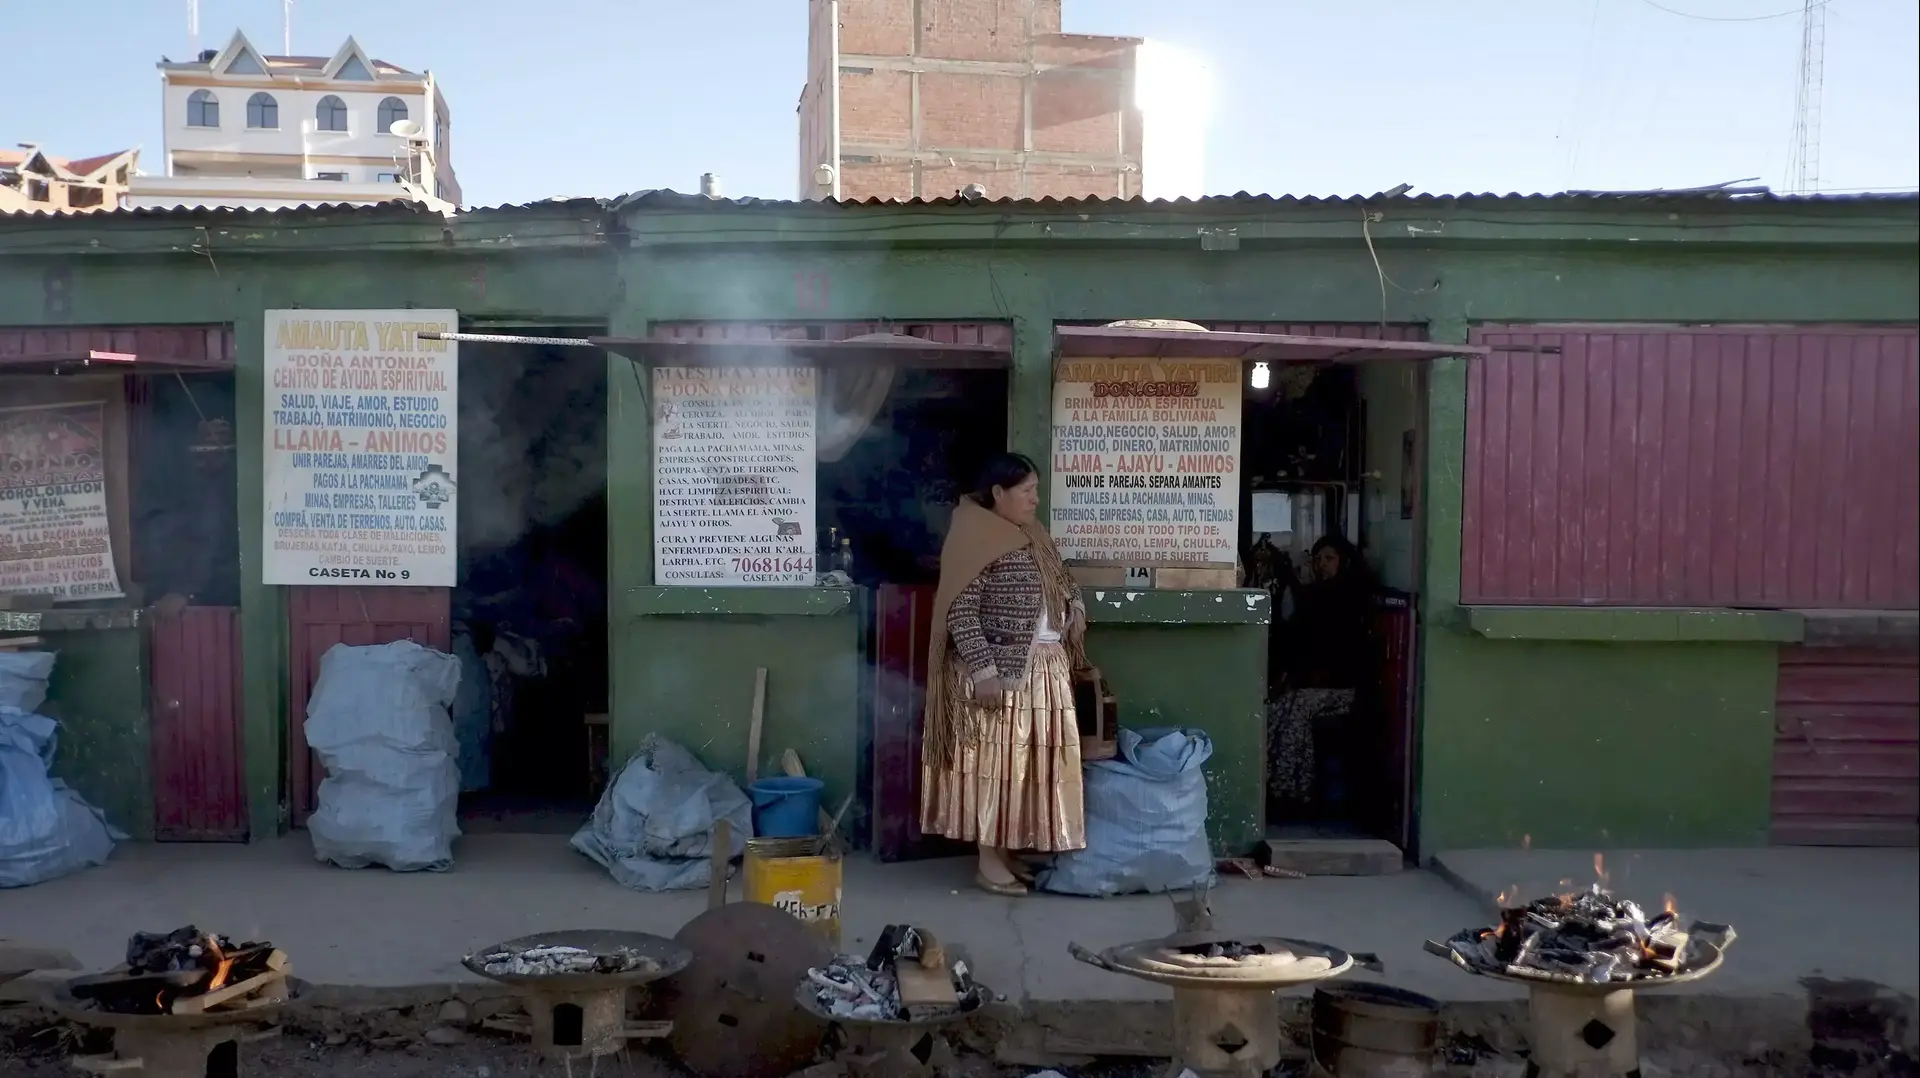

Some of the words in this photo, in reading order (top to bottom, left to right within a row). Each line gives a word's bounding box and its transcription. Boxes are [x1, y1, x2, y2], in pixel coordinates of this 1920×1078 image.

[276, 320, 369, 351] AMAUTA
[1055, 363, 1155, 383] AMAUTA
[1160, 363, 1237, 383] YATIRI
[274, 368, 318, 388] CENTRO
[323, 368, 337, 389] DE
[340, 369, 377, 390] AYUDA
[382, 370, 447, 392] ESPIRITUAL
[282, 394, 318, 410] SALUD,
[321, 395, 354, 410] VIAJE,
[358, 395, 390, 412] AMOR,
[394, 396, 438, 411] ESTUDIO
[1065, 398, 1108, 409] BRINDA
[1112, 398, 1152, 409] AYUDA
[1156, 398, 1224, 409] ESPIRITUAL
[273, 410, 323, 429] TRABAJO,
[327, 412, 396, 430] MATRIMONIO,
[400, 414, 446, 429] NEGOCIO
[1072, 411, 1080, 422] A
[1084, 411, 1098, 422] LA
[1103, 411, 1148, 422] FAMILIA
[1153, 411, 1217, 422] BOLIVIANA
[1163, 426, 1200, 440] SALUD,
[1204, 426, 1236, 438] AMOR
[274, 429, 342, 450] LLAMA
[365, 430, 446, 453] ANIMOS
[1059, 439, 1109, 454] ESTUDIO,
[1112, 439, 1156, 454] DINERO,
[1160, 439, 1229, 452] MATRIMONIO
[694, 445, 705, 453] LA
[293, 453, 311, 468] UNIR
[314, 453, 350, 471] PAREJAS,
[351, 454, 387, 470] AMARRES
[390, 455, 404, 470] DEL
[407, 456, 428, 471] AMOR
[1055, 454, 1102, 473] LLAMA
[1117, 455, 1164, 473] AJAYU
[1177, 455, 1234, 473] ANIMOS
[659, 466, 731, 474] COMPRA-VENTA
[314, 473, 339, 488] PAGOS
[341, 474, 345, 488] A
[348, 474, 358, 489] LA
[360, 475, 408, 490] PACHAMAMA
[759, 476, 780, 484] ETC.
[1066, 475, 1092, 488] UNION
[1094, 475, 1104, 488] DE
[1149, 476, 1180, 488] SEPARA
[1182, 476, 1221, 489] AMANTES
[659, 488, 684, 496] HACE
[305, 493, 332, 510] MINAS,
[334, 494, 376, 512] EMPRESAS,
[379, 495, 415, 510] TALLERES
[1071, 492, 1109, 505] RITUALES
[1112, 492, 1118, 505] A
[1120, 492, 1130, 505] LA
[1132, 492, 1185, 507] PACHAMAMA,
[1188, 493, 1215, 507] MINAS,
[747, 508, 759, 516] EL
[761, 506, 792, 515] ÁNIMO
[1052, 508, 1098, 523] TERRENOS,
[1100, 509, 1144, 524] EMPRESAS,
[1147, 509, 1170, 524] CASA,
[1172, 509, 1196, 524] AUTO,
[1199, 509, 1233, 522] TIENDAS
[311, 514, 335, 529] VENTA
[338, 515, 347, 529] DE
[278, 529, 316, 538] DESECHA
[319, 530, 339, 539] TODA
[342, 531, 368, 540] CLASE
[371, 531, 381, 540] DE
[1066, 525, 1121, 535] ACABAMOS
[1123, 525, 1144, 535] CON
[1148, 525, 1174, 535] TODO
[1178, 525, 1200, 535] TIPO
[1204, 526, 1219, 535] DE:
[699, 535, 746, 543] PREVIENE
[1144, 538, 1180, 550] LEMPU,
[1183, 539, 1230, 550] CHULLPA,
[418, 545, 446, 554] LEMPO
[744, 546, 771, 554] K’ARI
[319, 554, 350, 564] CAMBIO
[353, 555, 364, 564] DE
[1113, 551, 1152, 561] CAMBIO
[1154, 551, 1167, 561] DE
[1170, 552, 1209, 561] SUERTE
[732, 557, 813, 573] 70681644
[309, 568, 370, 578] CASETA
[376, 570, 396, 579] No
[401, 570, 410, 579] 9
[665, 571, 723, 579] CONSULTAS:
[742, 574, 780, 582] CASETA
